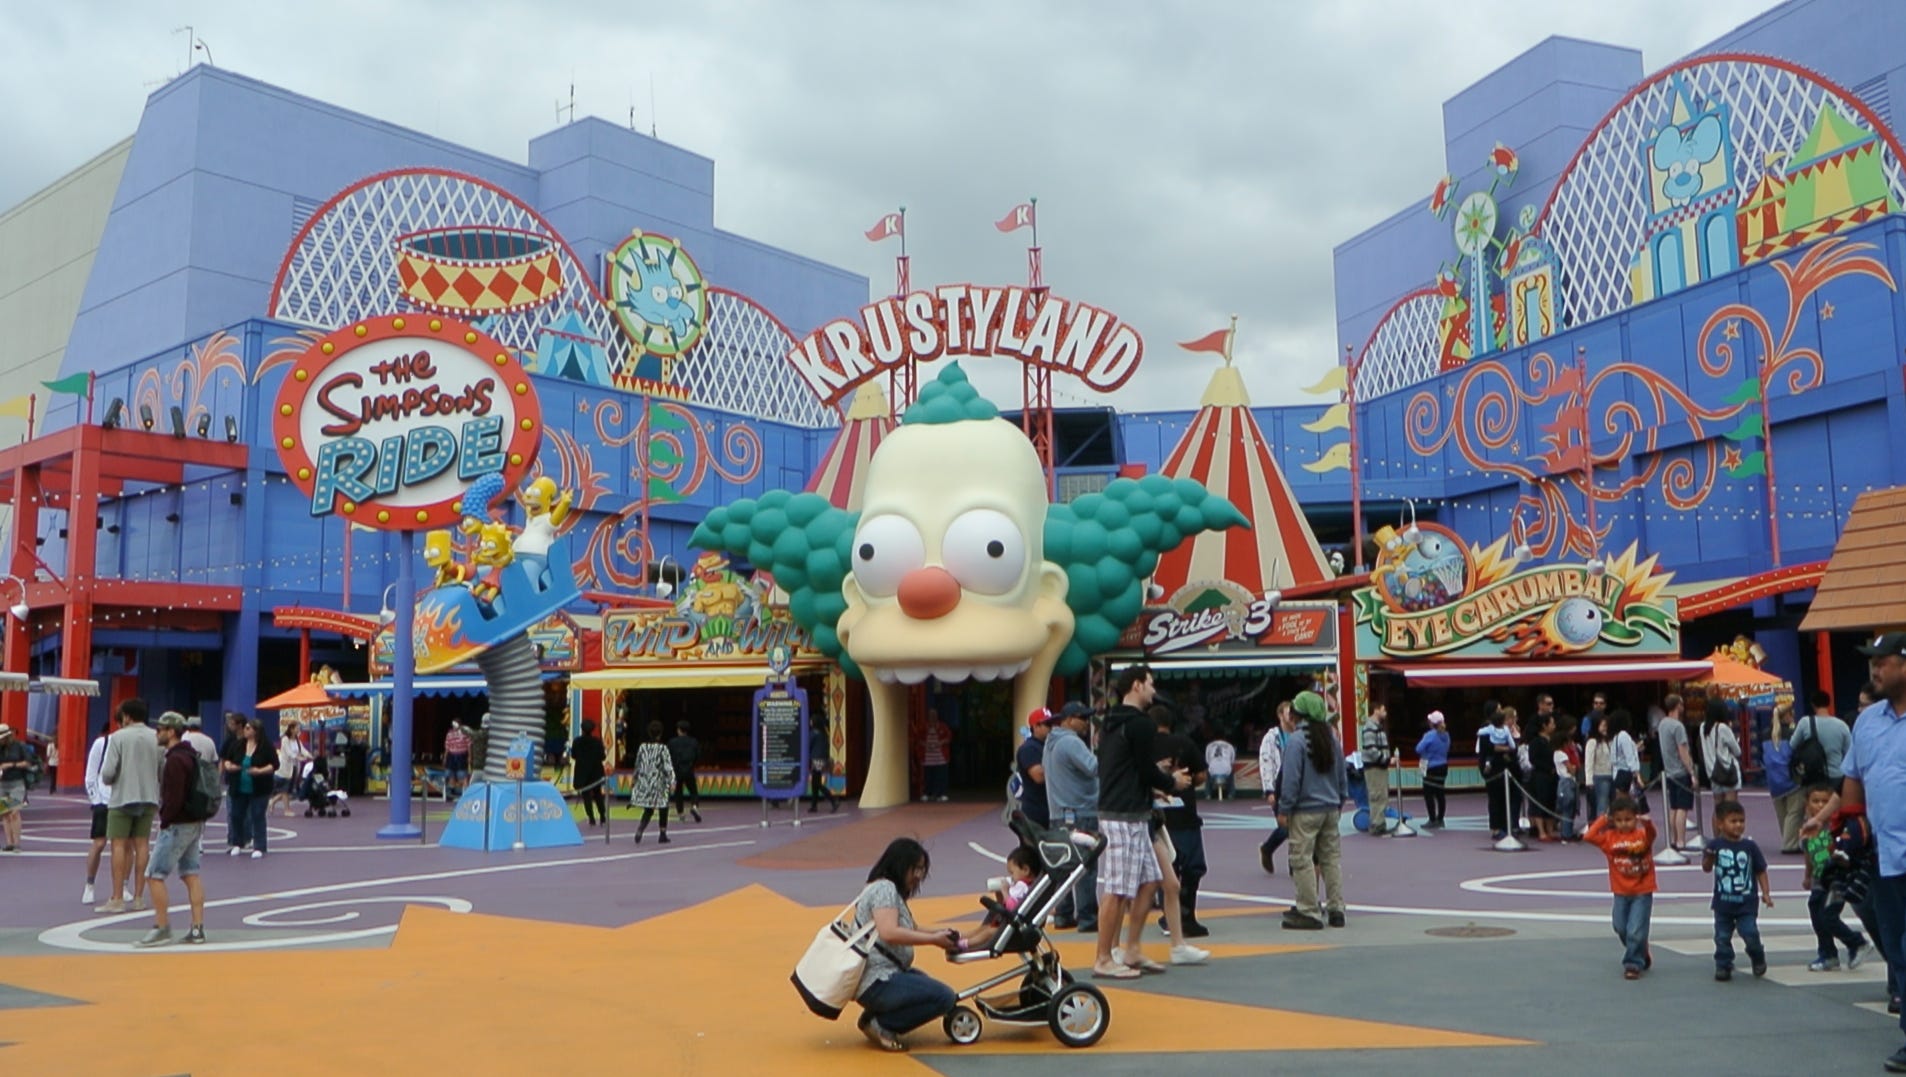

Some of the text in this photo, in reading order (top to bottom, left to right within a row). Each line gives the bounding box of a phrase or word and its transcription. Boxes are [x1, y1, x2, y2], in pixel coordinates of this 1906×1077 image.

[885, 215, 898, 236] K
[1016, 205, 1029, 226] K
[369, 350, 437, 385] THE
[787, 284, 1144, 407] KRUSTYLAND
[317, 372, 495, 436] SIMPSONS
[310, 415, 507, 517] RIDE
[1143, 607, 1227, 649] Strike
[1246, 600, 1272, 636] 3
[1387, 568, 1614, 650] EYE CARUMBA!
[704, 639, 735, 658] AND
